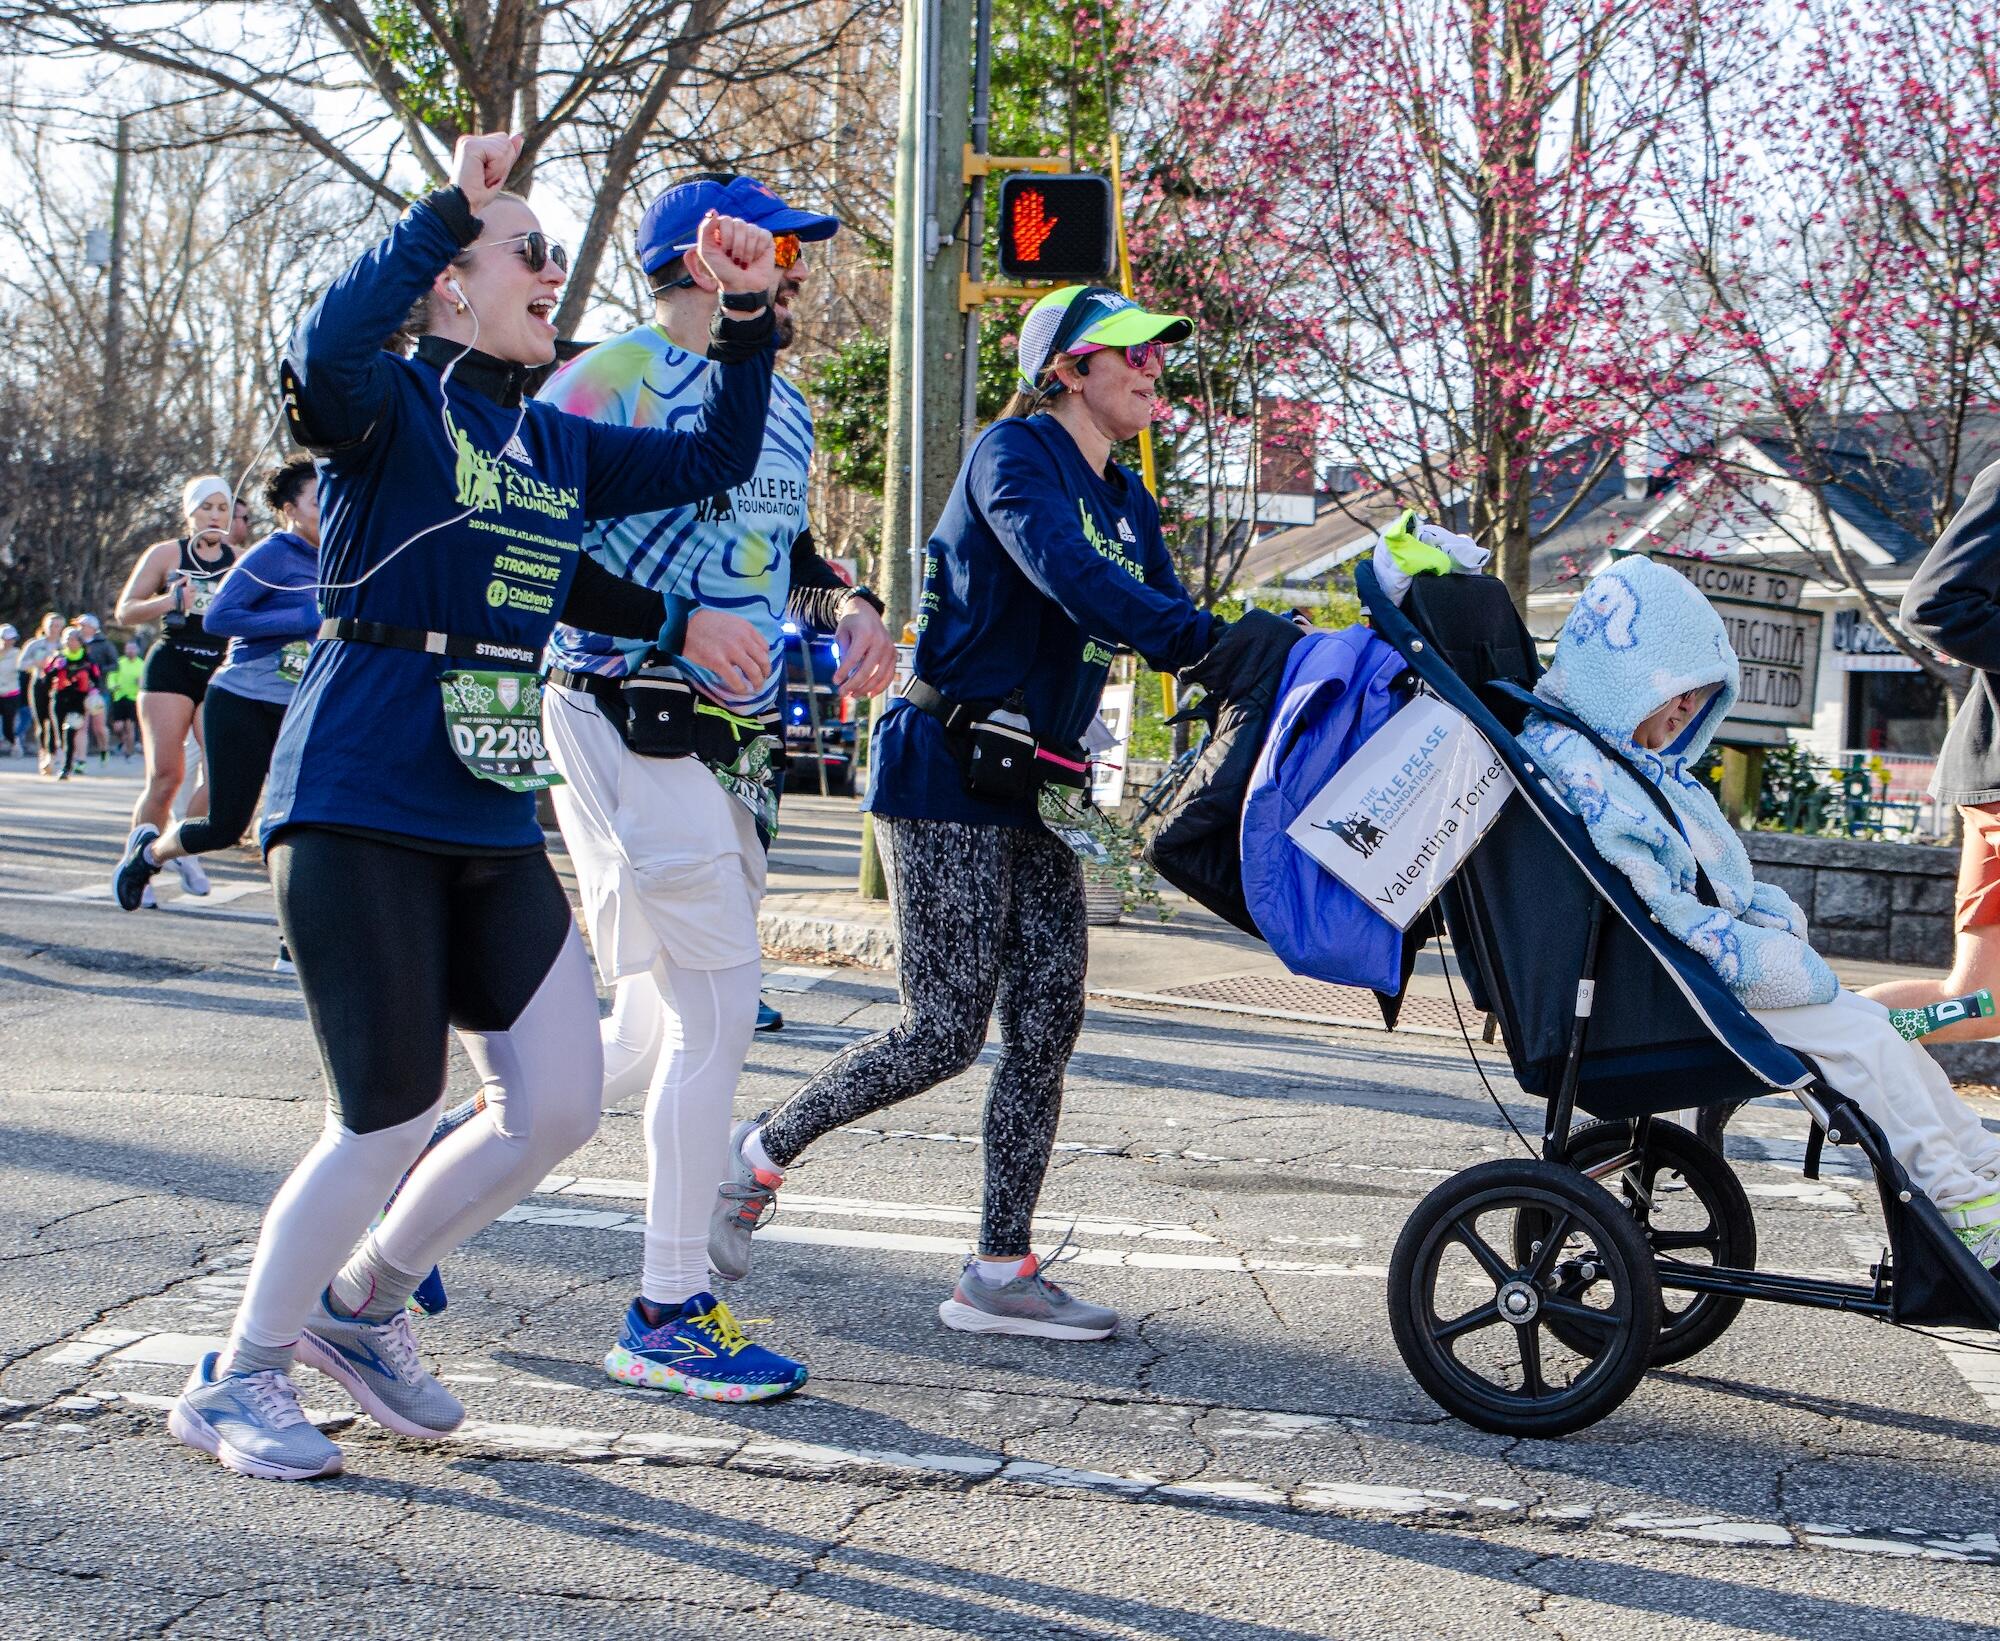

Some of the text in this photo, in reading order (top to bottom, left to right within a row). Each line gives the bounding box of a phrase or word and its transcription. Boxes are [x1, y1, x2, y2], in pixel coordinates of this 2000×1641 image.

[779, 479, 807, 501] PEA
[737, 499, 800, 517] FOUNDATION
[468, 519, 490, 531] 2024
[490, 523, 517, 538] PUBLIX
[516, 530, 545, 545] ATLANTA
[1108, 539, 1123, 555] THE
[1675, 565, 1788, 599] ELCOME TO
[508, 587, 555, 608] Children's
[1722, 616, 1806, 664] IRGINIA
[452, 723, 547, 761] D2288
[1368, 725, 1448, 817] KYLE PEASE
[1359, 786, 1380, 806] THE
[1380, 760, 1435, 825] FOUNDATION
[1408, 785, 1427, 807] BEYOND
[1376, 757, 1505, 906] Valentina Torres
[1935, 1001, 1965, 1022] D
